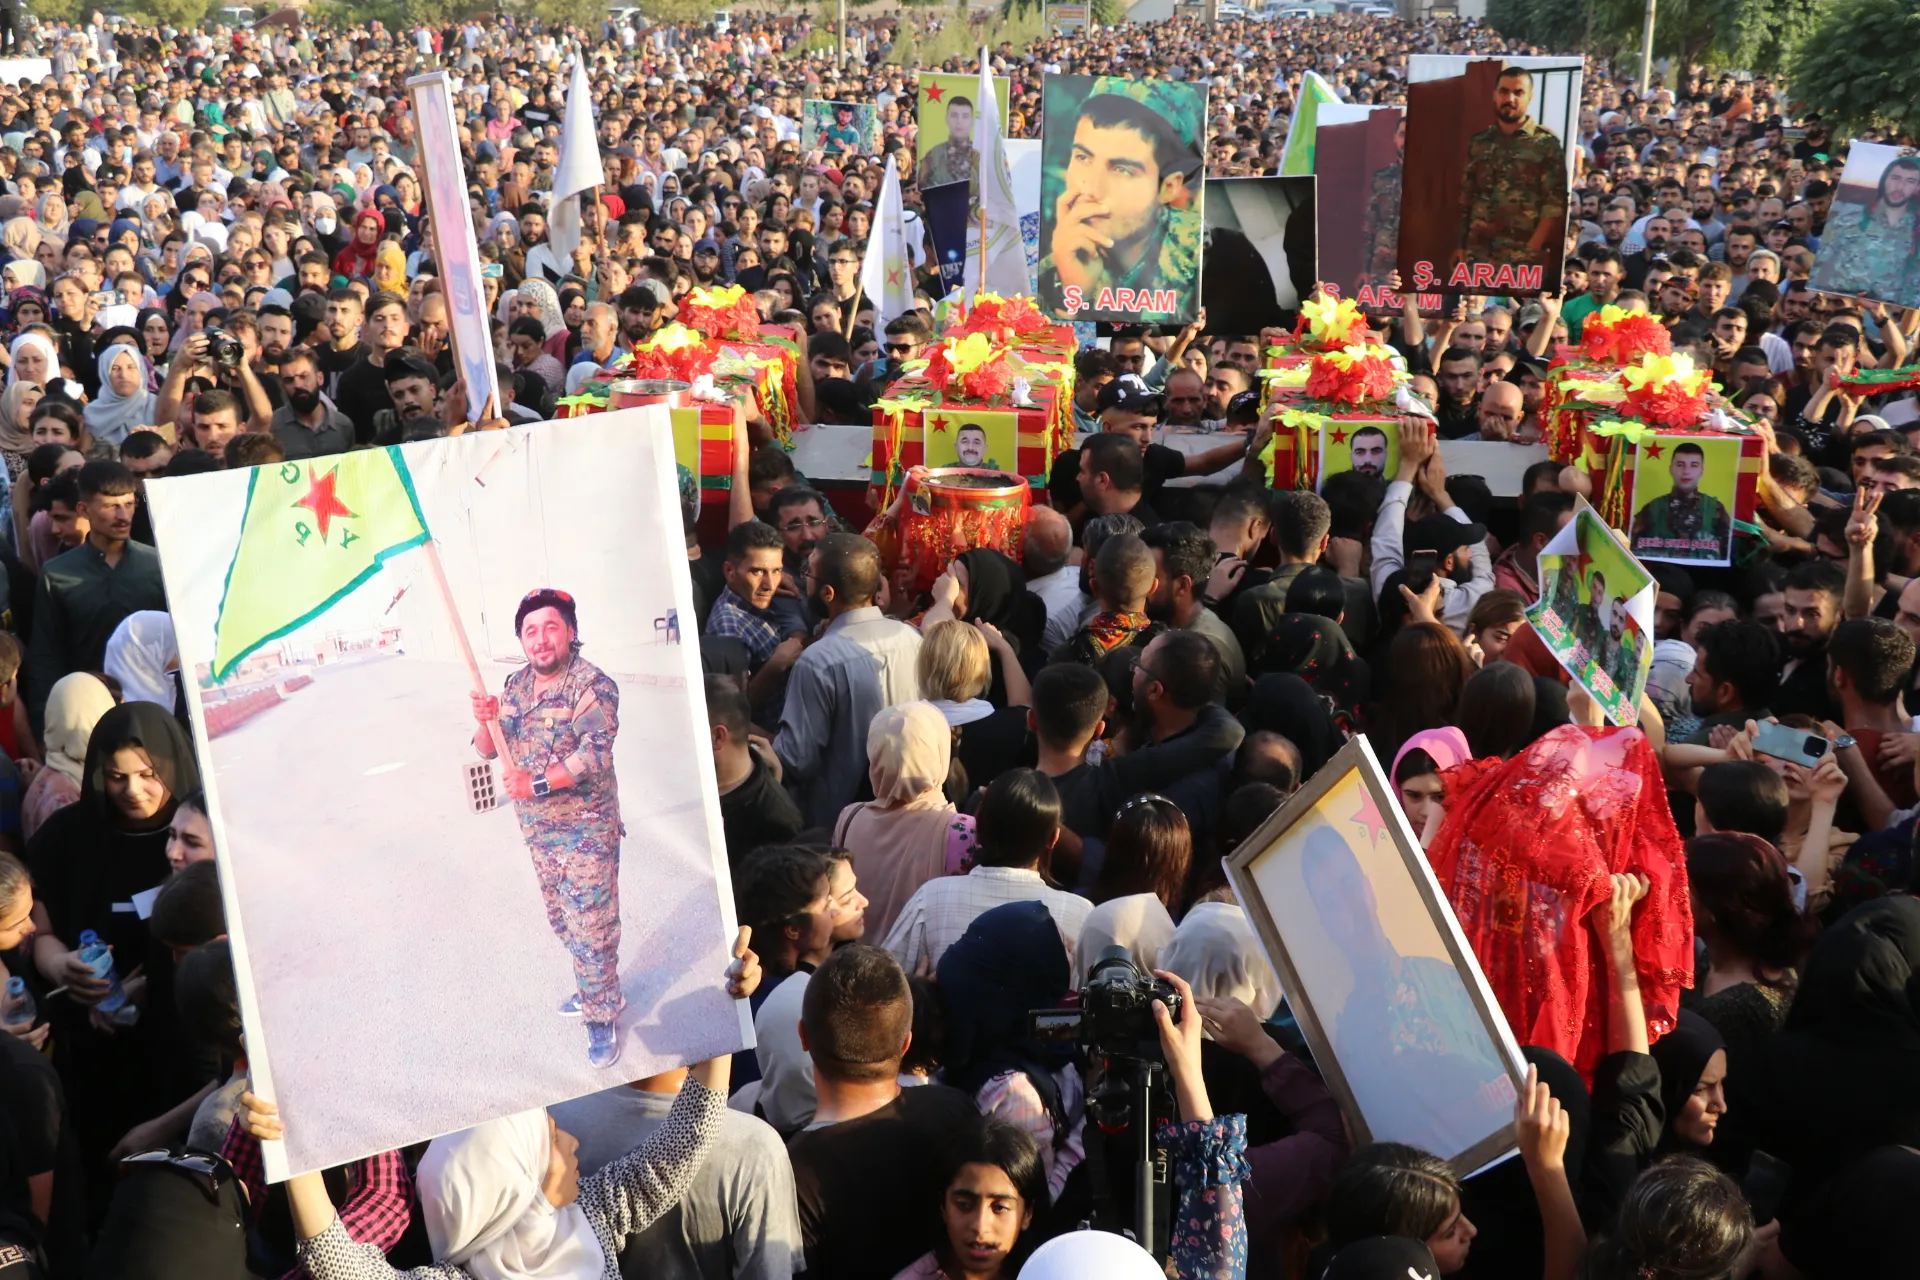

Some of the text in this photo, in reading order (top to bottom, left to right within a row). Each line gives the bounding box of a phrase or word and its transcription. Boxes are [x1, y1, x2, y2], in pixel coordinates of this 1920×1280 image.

[1413, 261, 1543, 290] Ş. ARAM
[1064, 285, 1176, 314] Ş. ARAM
[1356, 284, 1442, 310] ARM
